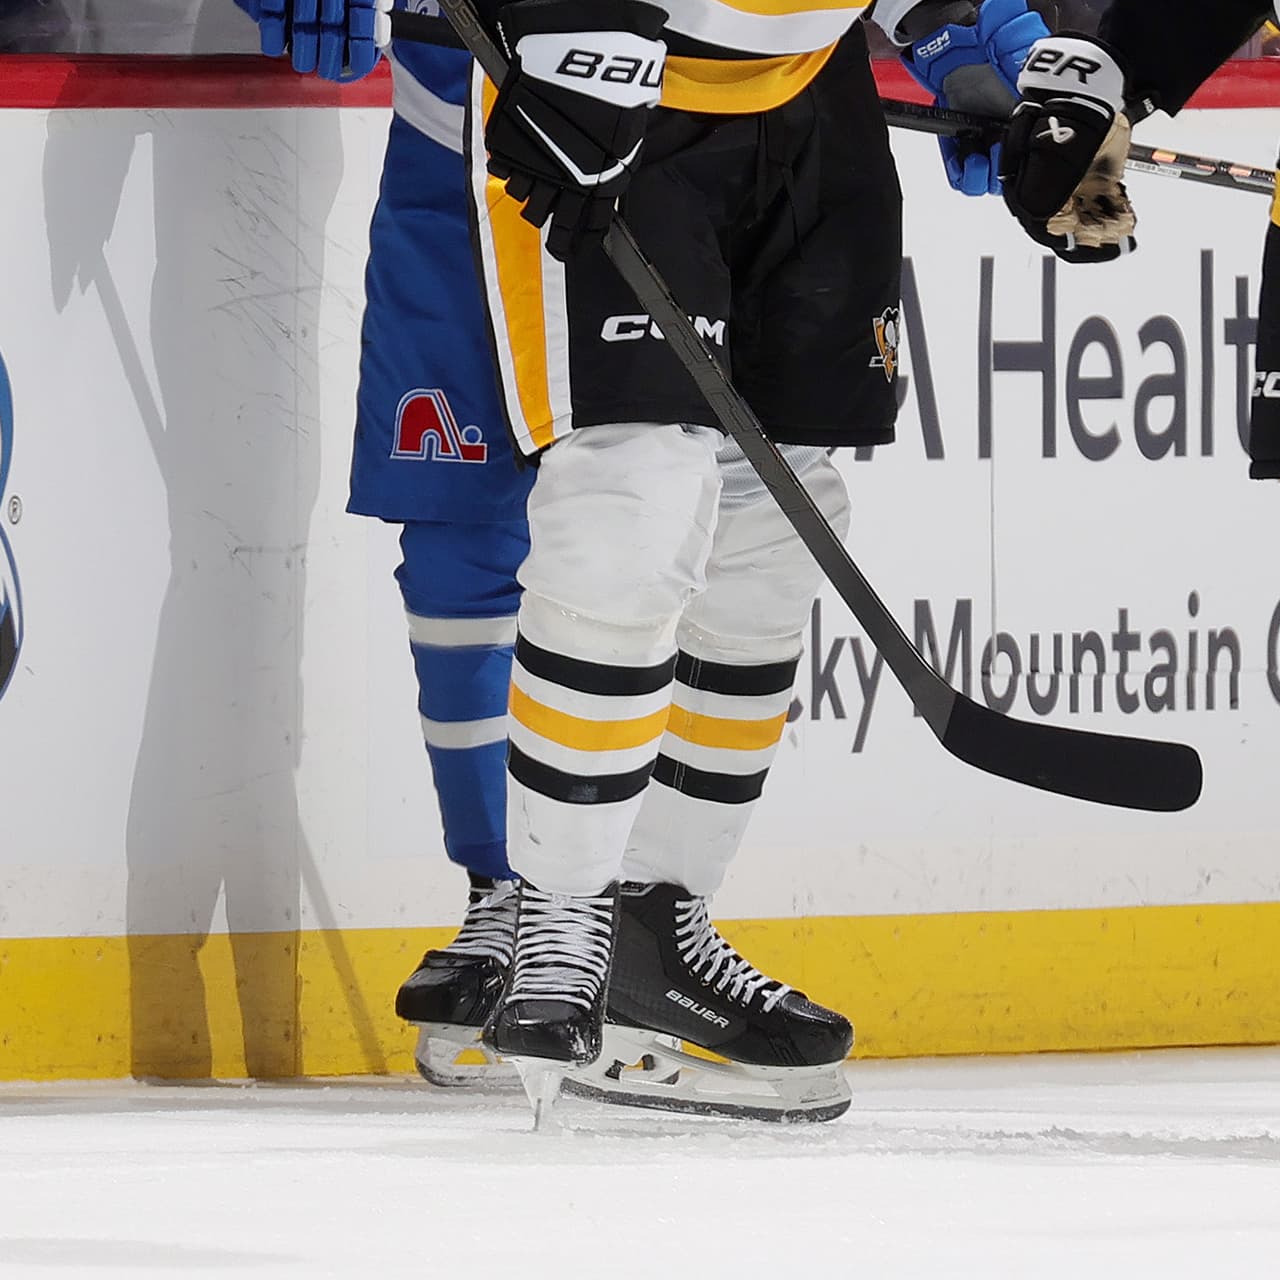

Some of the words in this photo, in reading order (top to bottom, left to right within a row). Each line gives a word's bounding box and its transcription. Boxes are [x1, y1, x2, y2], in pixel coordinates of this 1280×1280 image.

[916, 29, 952, 58] CCM
[978, 247, 1261, 463] Healt
[913, 589, 1241, 716] Mountain
